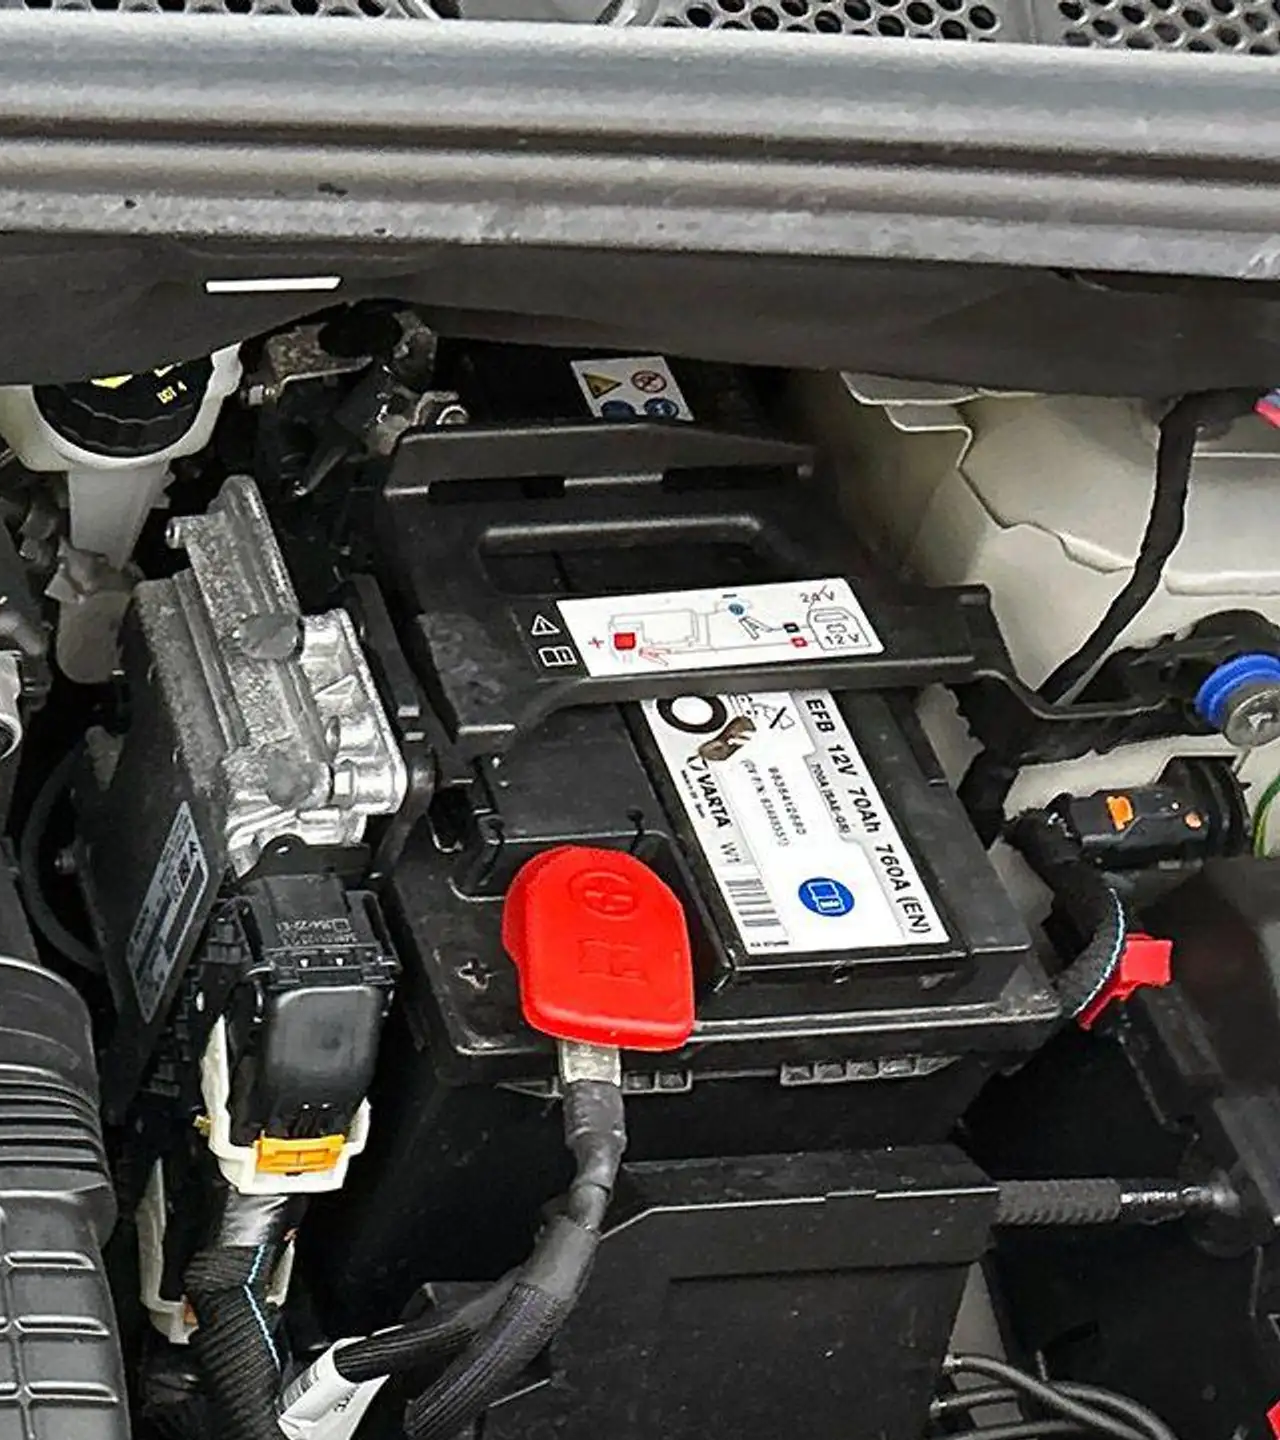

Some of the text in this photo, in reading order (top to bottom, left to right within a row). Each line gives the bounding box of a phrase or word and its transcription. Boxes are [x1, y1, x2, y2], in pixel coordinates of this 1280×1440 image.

[697, 773, 732, 829] VARTA
[806, 698, 932, 935] EFB 12V 70Ah 760A (EN)
